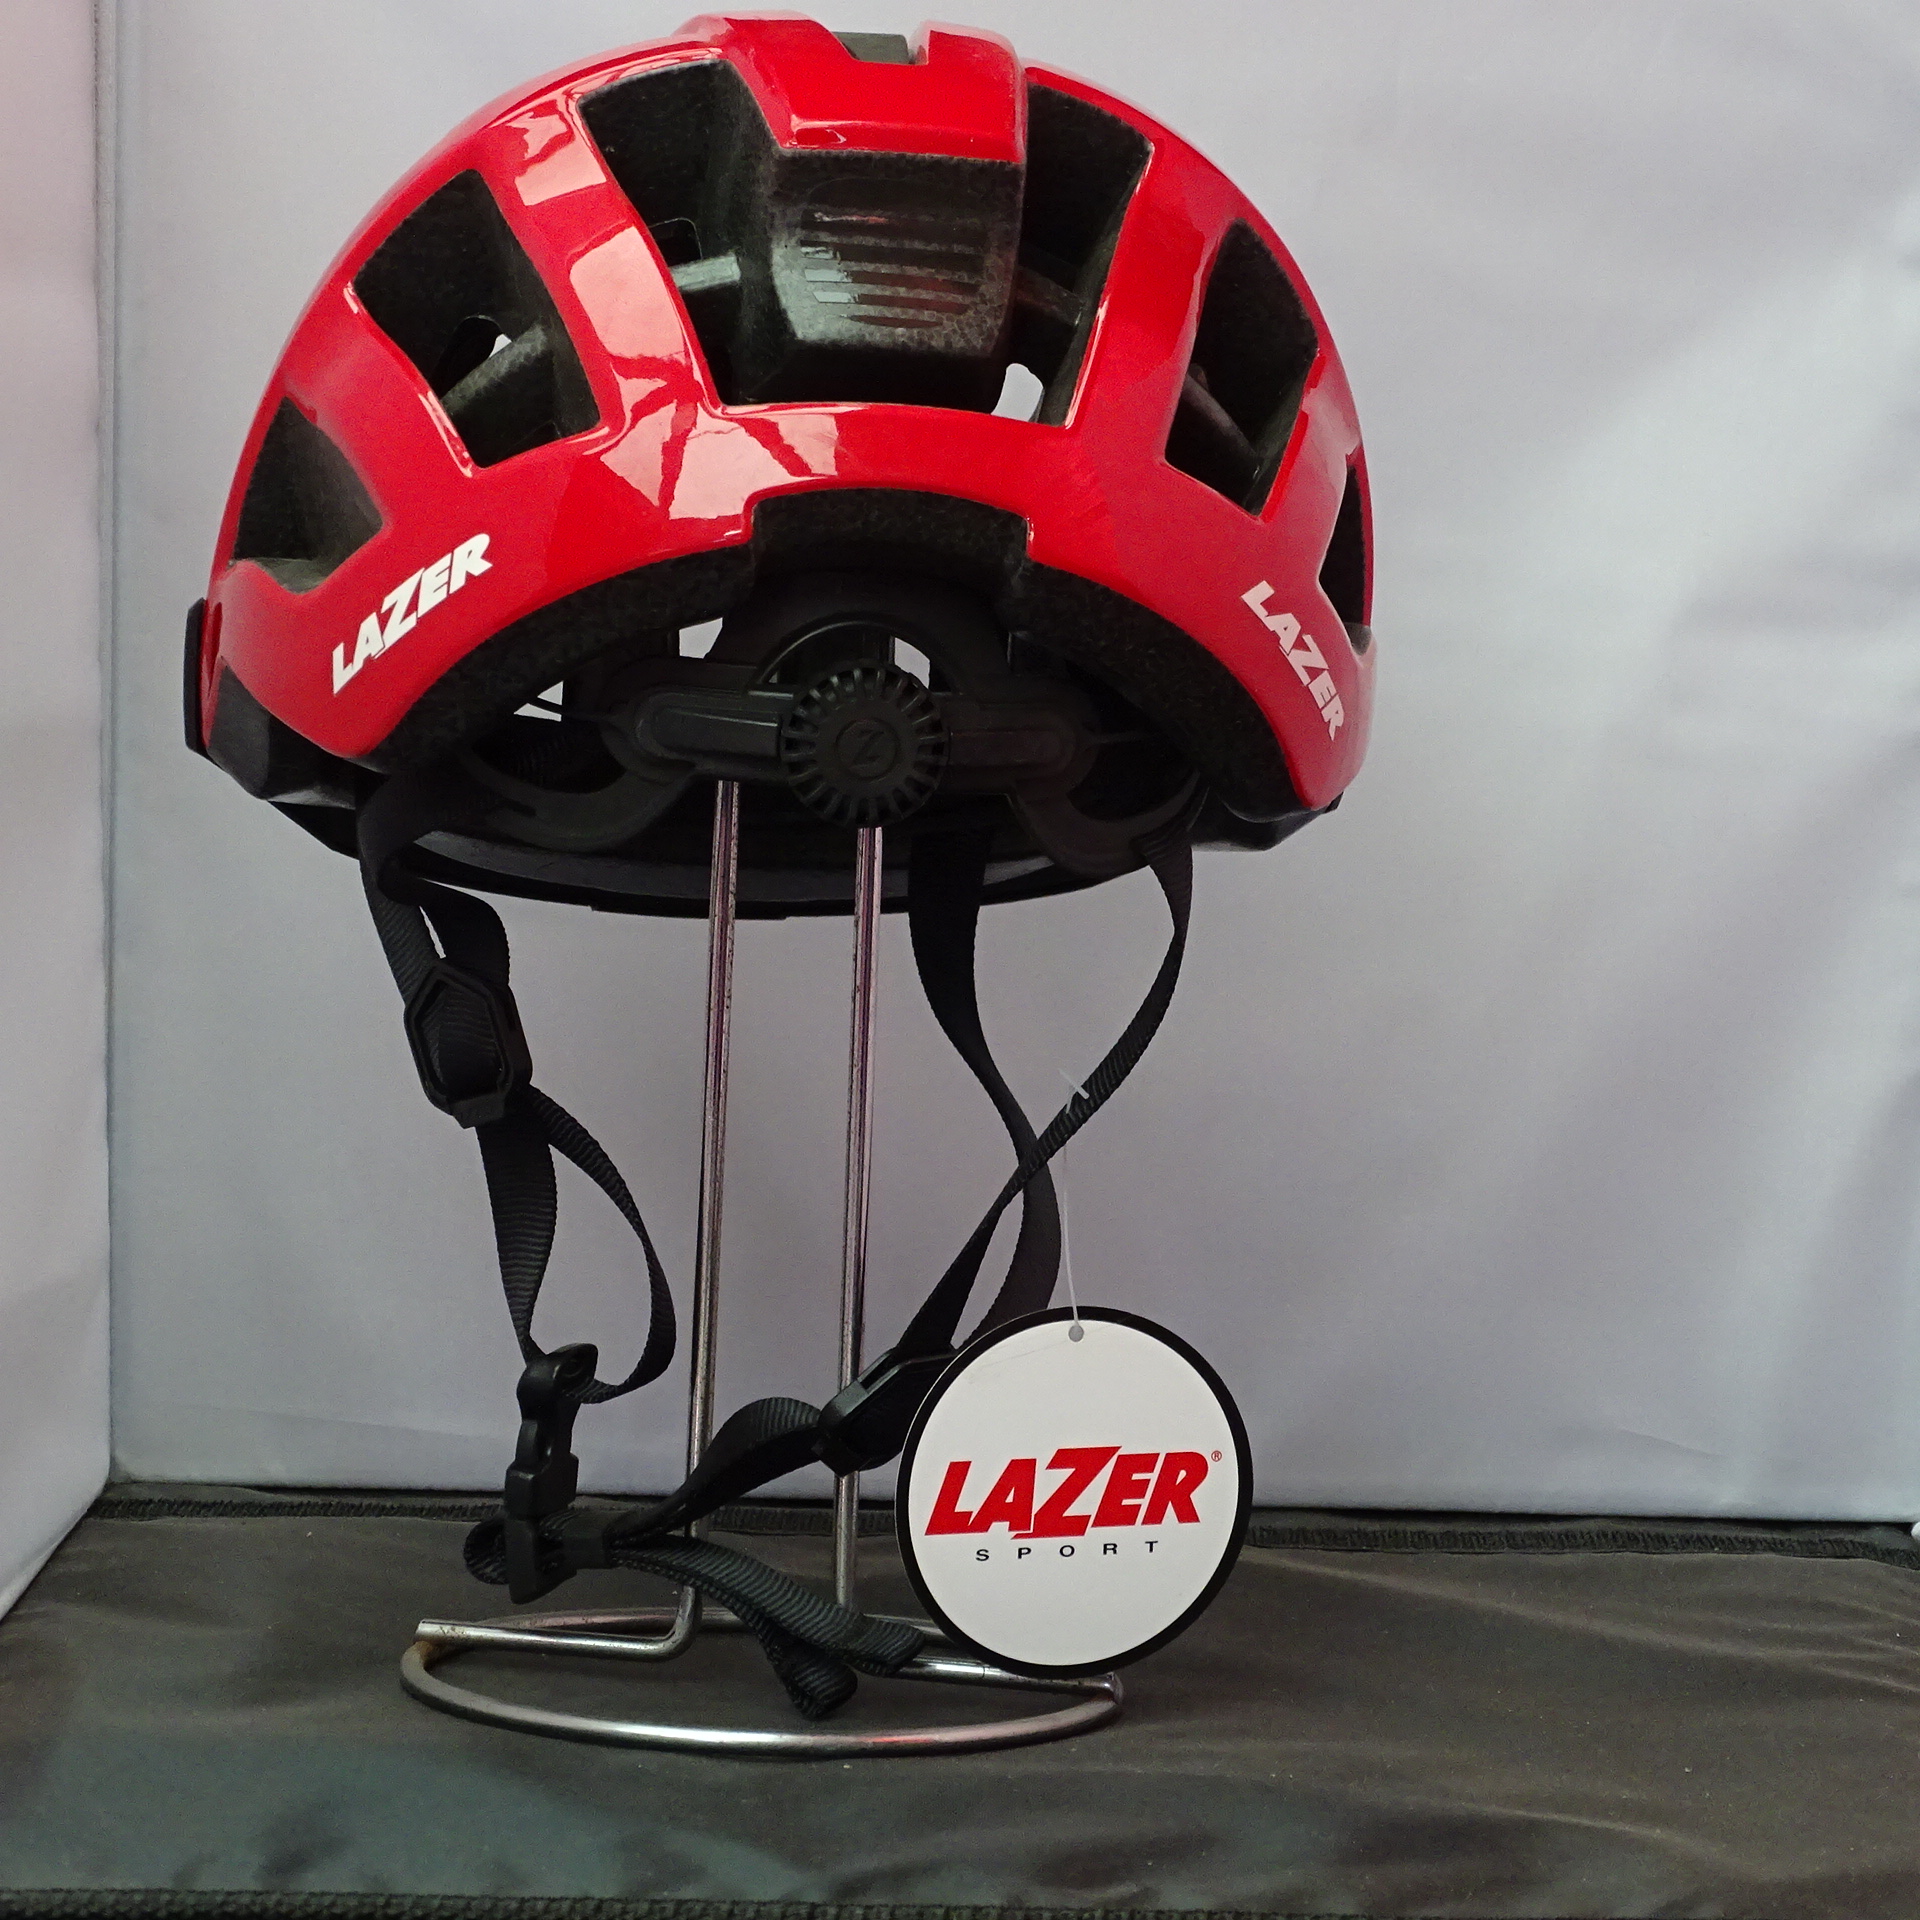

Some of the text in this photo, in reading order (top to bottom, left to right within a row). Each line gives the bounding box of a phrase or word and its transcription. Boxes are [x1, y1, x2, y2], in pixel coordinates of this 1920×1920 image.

[332, 533, 493, 695] LAZER
[1241, 580, 1345, 742] LAZER
[975, 1540, 1159, 1562] SPORT
